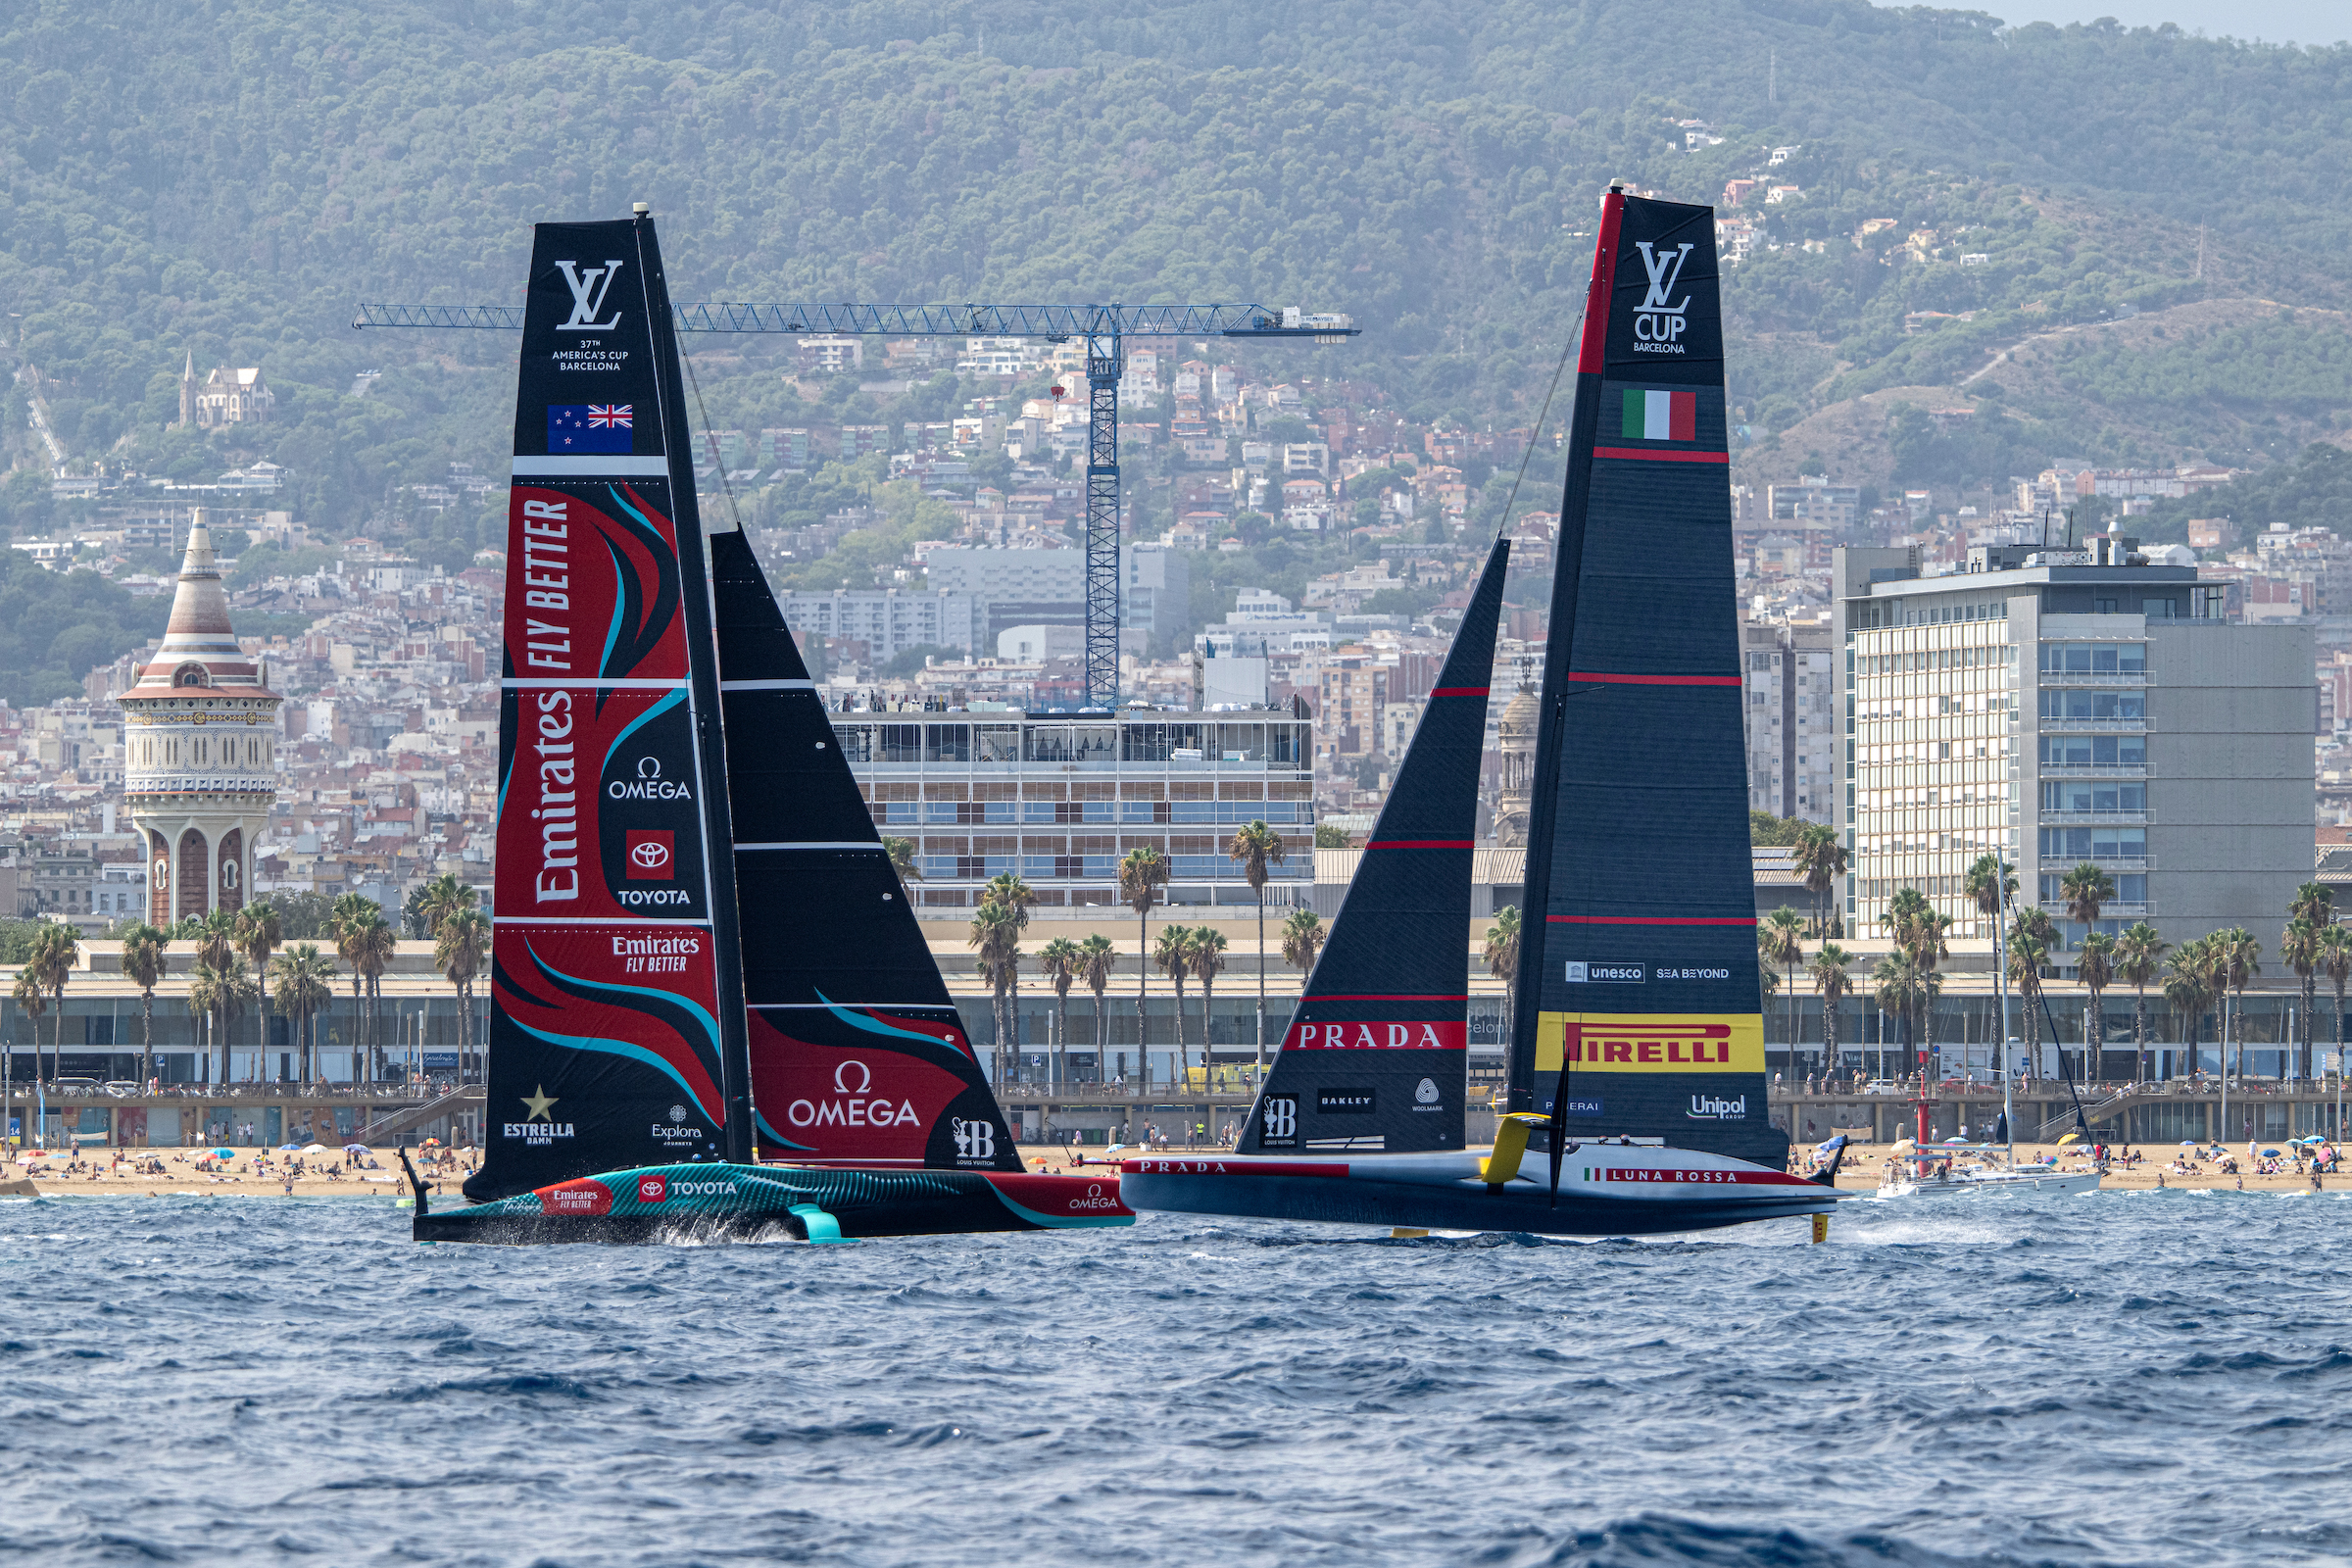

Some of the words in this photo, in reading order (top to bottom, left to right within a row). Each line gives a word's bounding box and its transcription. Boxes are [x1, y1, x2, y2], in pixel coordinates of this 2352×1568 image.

[1634, 314, 1687, 342] CUP
[580, 339, 601, 349] 37TH
[1634, 342, 1686, 355] BARCELONA
[552, 351, 607, 361] AMERICA'S
[609, 351, 629, 361] CUP
[560, 362, 620, 371] BARCELONA
[523, 499, 569, 611] BETTER
[526, 618, 571, 669] FLY
[531, 690, 579, 904] Emirates
[609, 781, 692, 800] OMEGA
[617, 890, 691, 905] TOYOTA
[612, 935, 700, 956] Emirates
[626, 956, 644, 972] FLY
[648, 956, 687, 972] BETTER
[1591, 967, 1642, 980] unesco
[1656, 967, 1679, 979] SEA
[1681, 967, 1730, 979] BEYOND
[1298, 1023, 1442, 1049] PRADA
[1565, 1022, 1732, 1063] PIRELLI
[788, 1098, 921, 1128] OMEGA
[1545, 1102, 1598, 1111] PERAI
[1691, 1094, 1745, 1119] Unipol
[10, 1127, 21, 1136] 14
[504, 1122, 575, 1137] ESTRELLA
[652, 1123, 703, 1140] Explora
[1141, 1160, 1227, 1173] PRADA
[1612, 1170, 1663, 1182] LUNA
[1675, 1171, 1737, 1183] ROSSA
[554, 1189, 598, 1200] Emirates
[671, 1182, 737, 1196] TOYOTA
[1069, 1197, 1119, 1209] OMEGA
